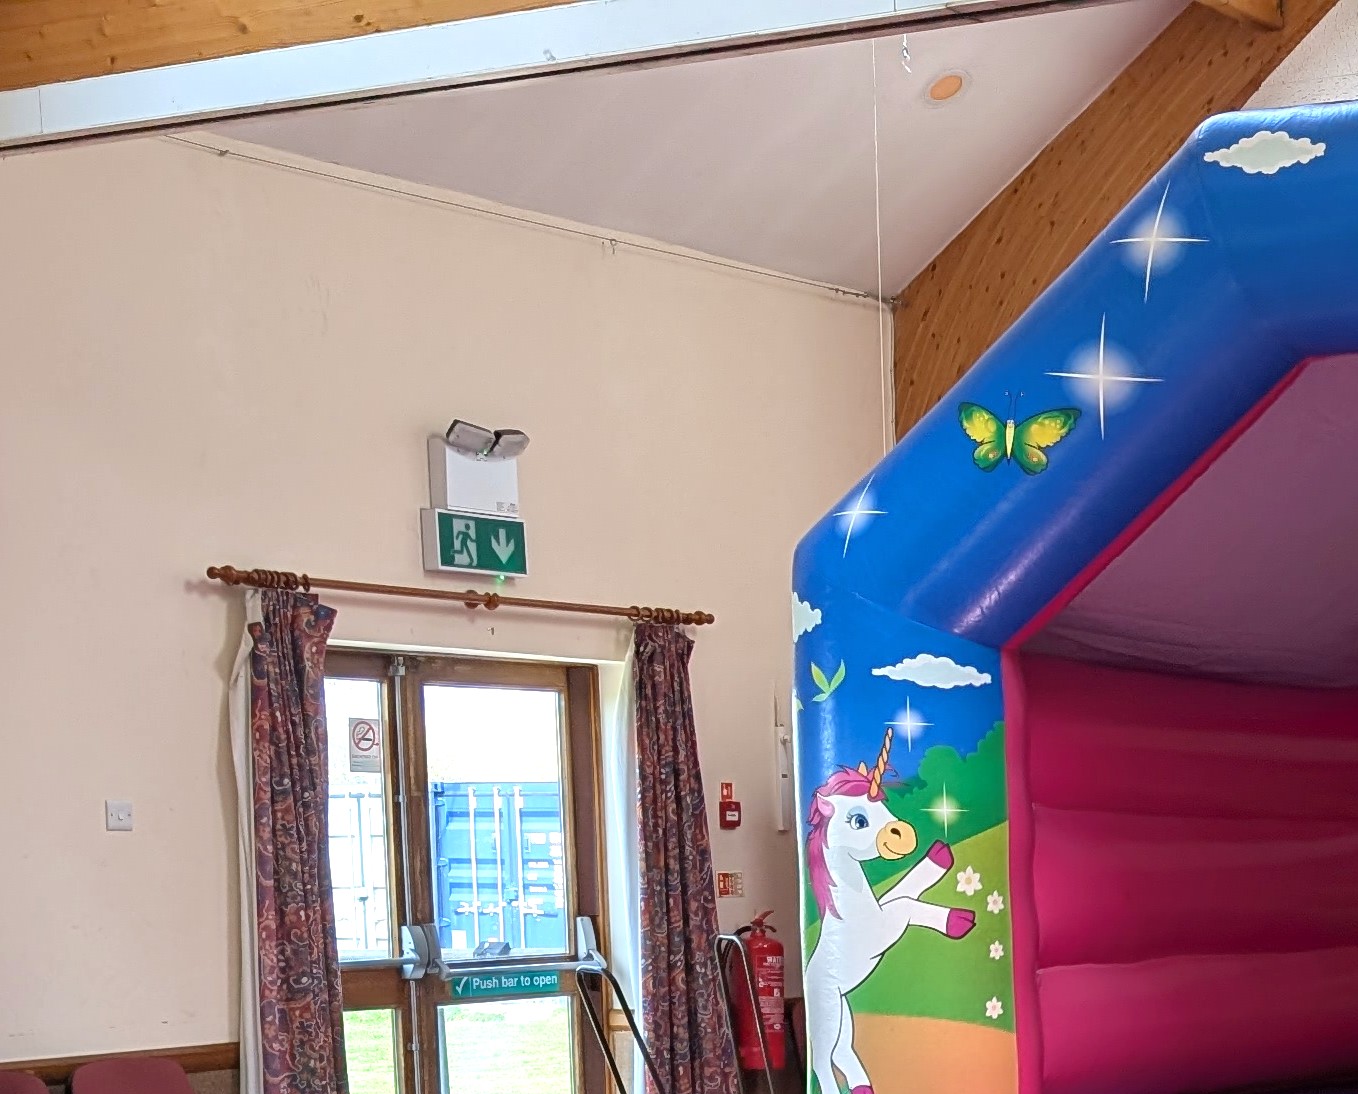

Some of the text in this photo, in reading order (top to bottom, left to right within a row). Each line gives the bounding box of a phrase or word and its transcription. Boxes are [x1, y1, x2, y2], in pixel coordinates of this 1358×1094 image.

[472, 975, 557, 989] Push bar to open
